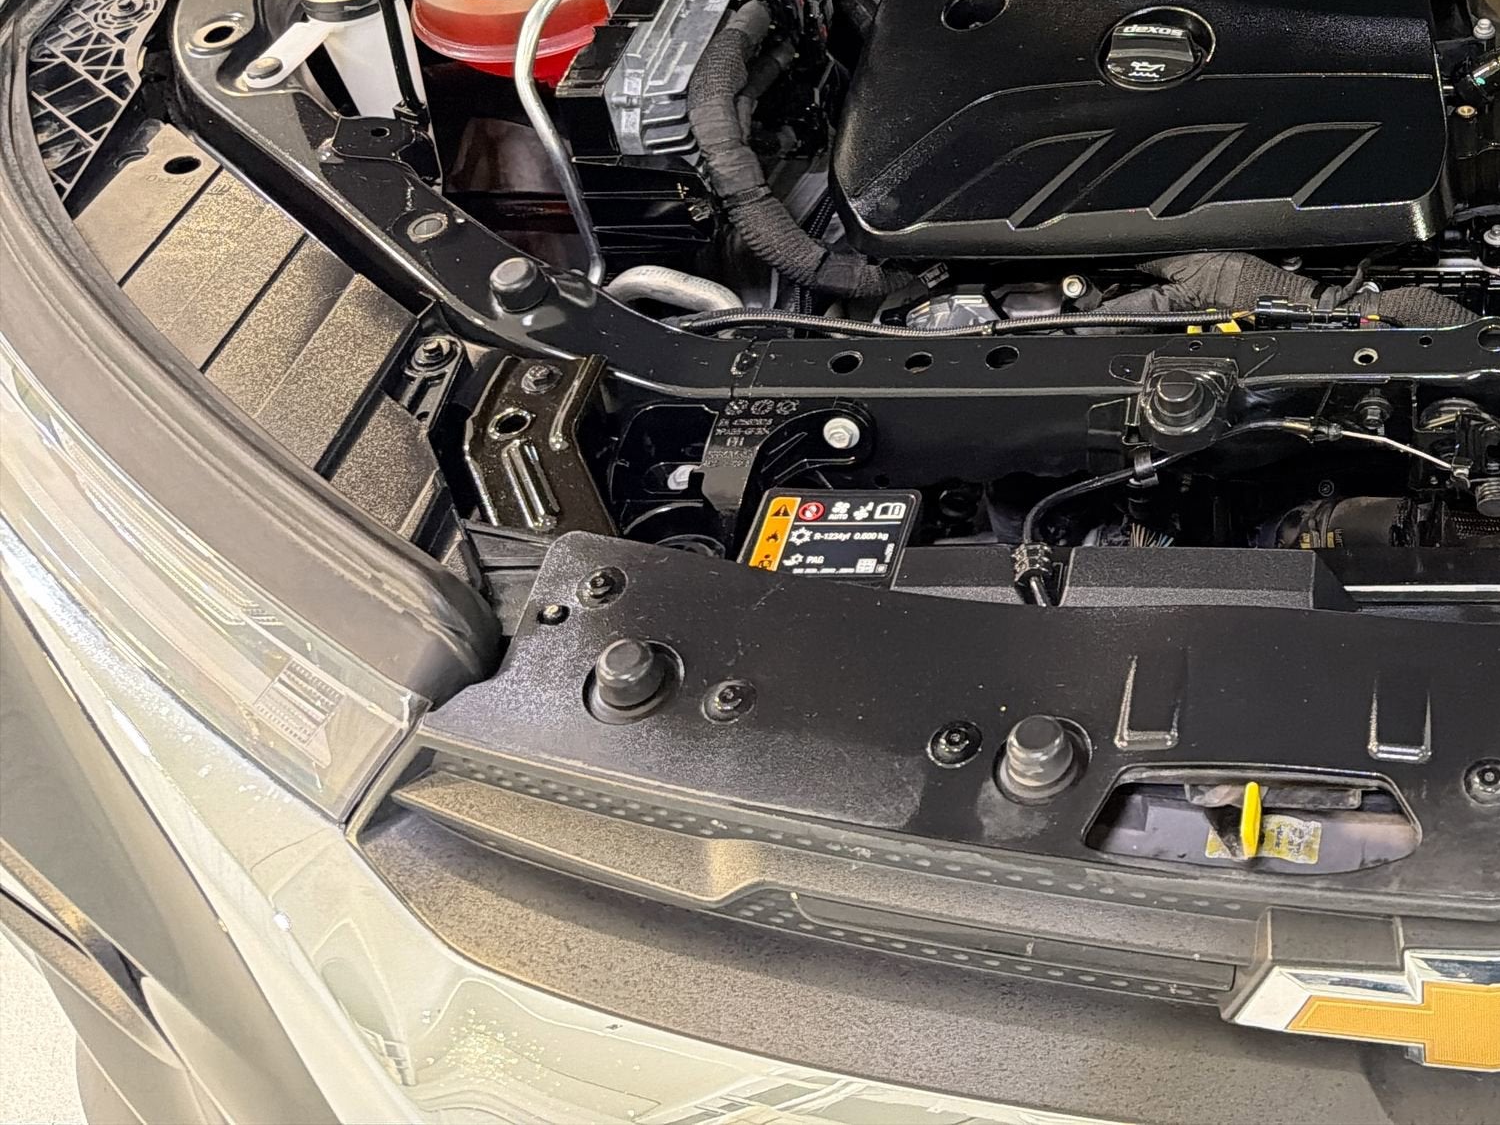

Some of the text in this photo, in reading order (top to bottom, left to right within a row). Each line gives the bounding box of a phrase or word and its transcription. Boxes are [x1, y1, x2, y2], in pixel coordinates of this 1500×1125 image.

[1122, 24, 1183, 36] dexos
[813, 532, 851, 541] R-1234yf
[878, 532, 889, 541] kg
[806, 556, 825, 564] PAG
